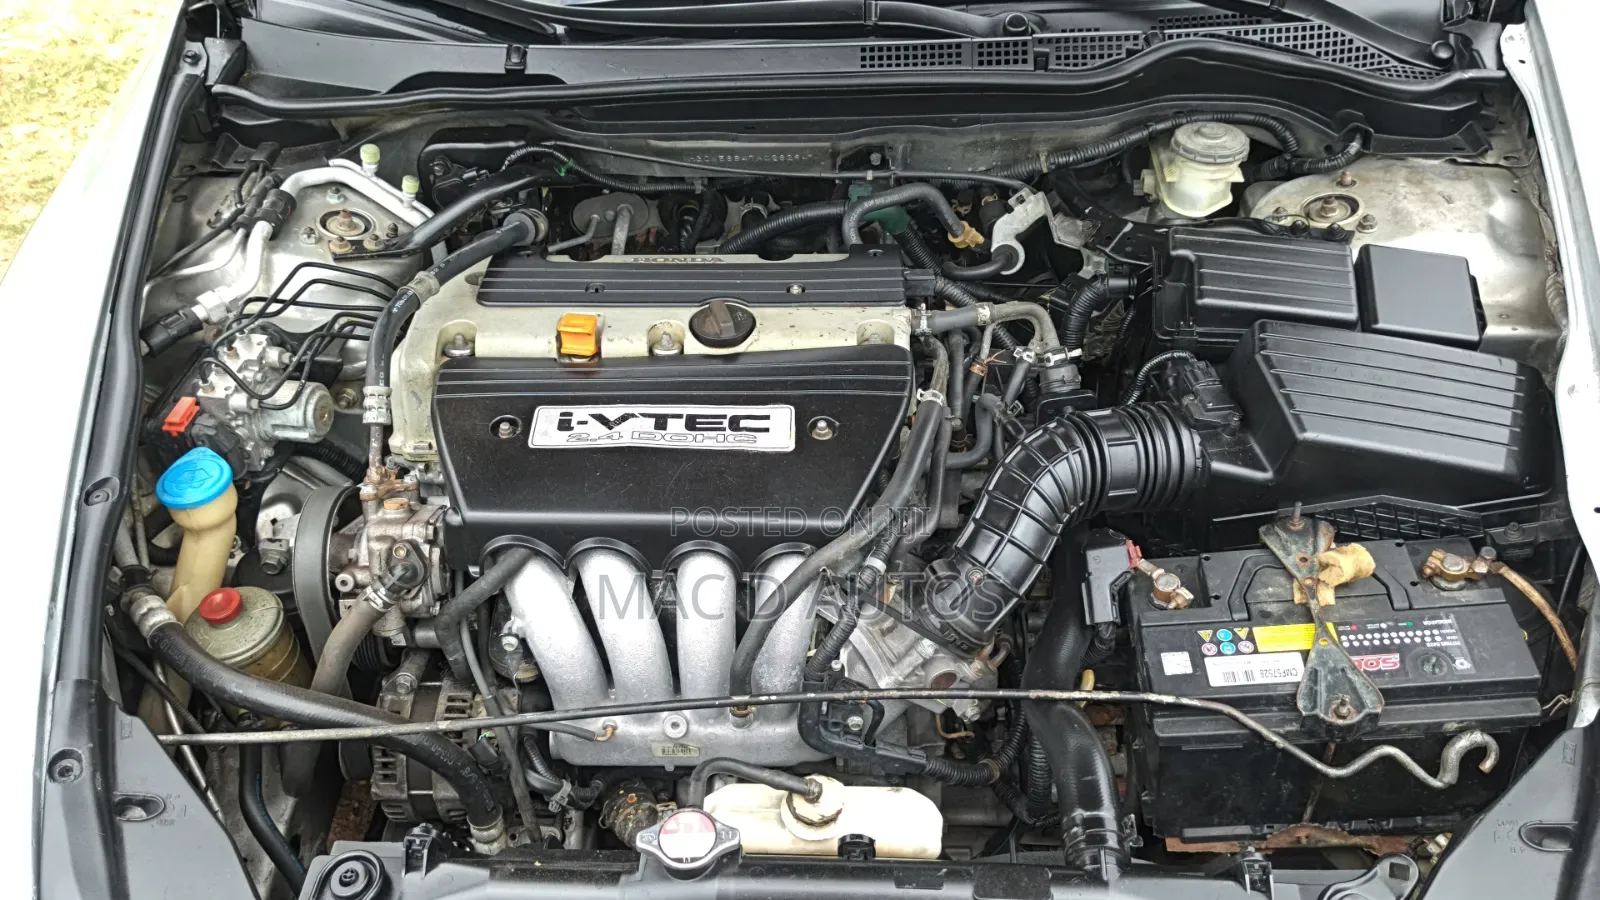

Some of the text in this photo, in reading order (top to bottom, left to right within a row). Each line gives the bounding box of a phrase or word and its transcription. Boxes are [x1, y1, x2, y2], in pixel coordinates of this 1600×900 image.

[632, 257, 726, 265] HONDA
[557, 411, 771, 432] i-VTEC
[566, 431, 757, 443] 2.4 DOHC
